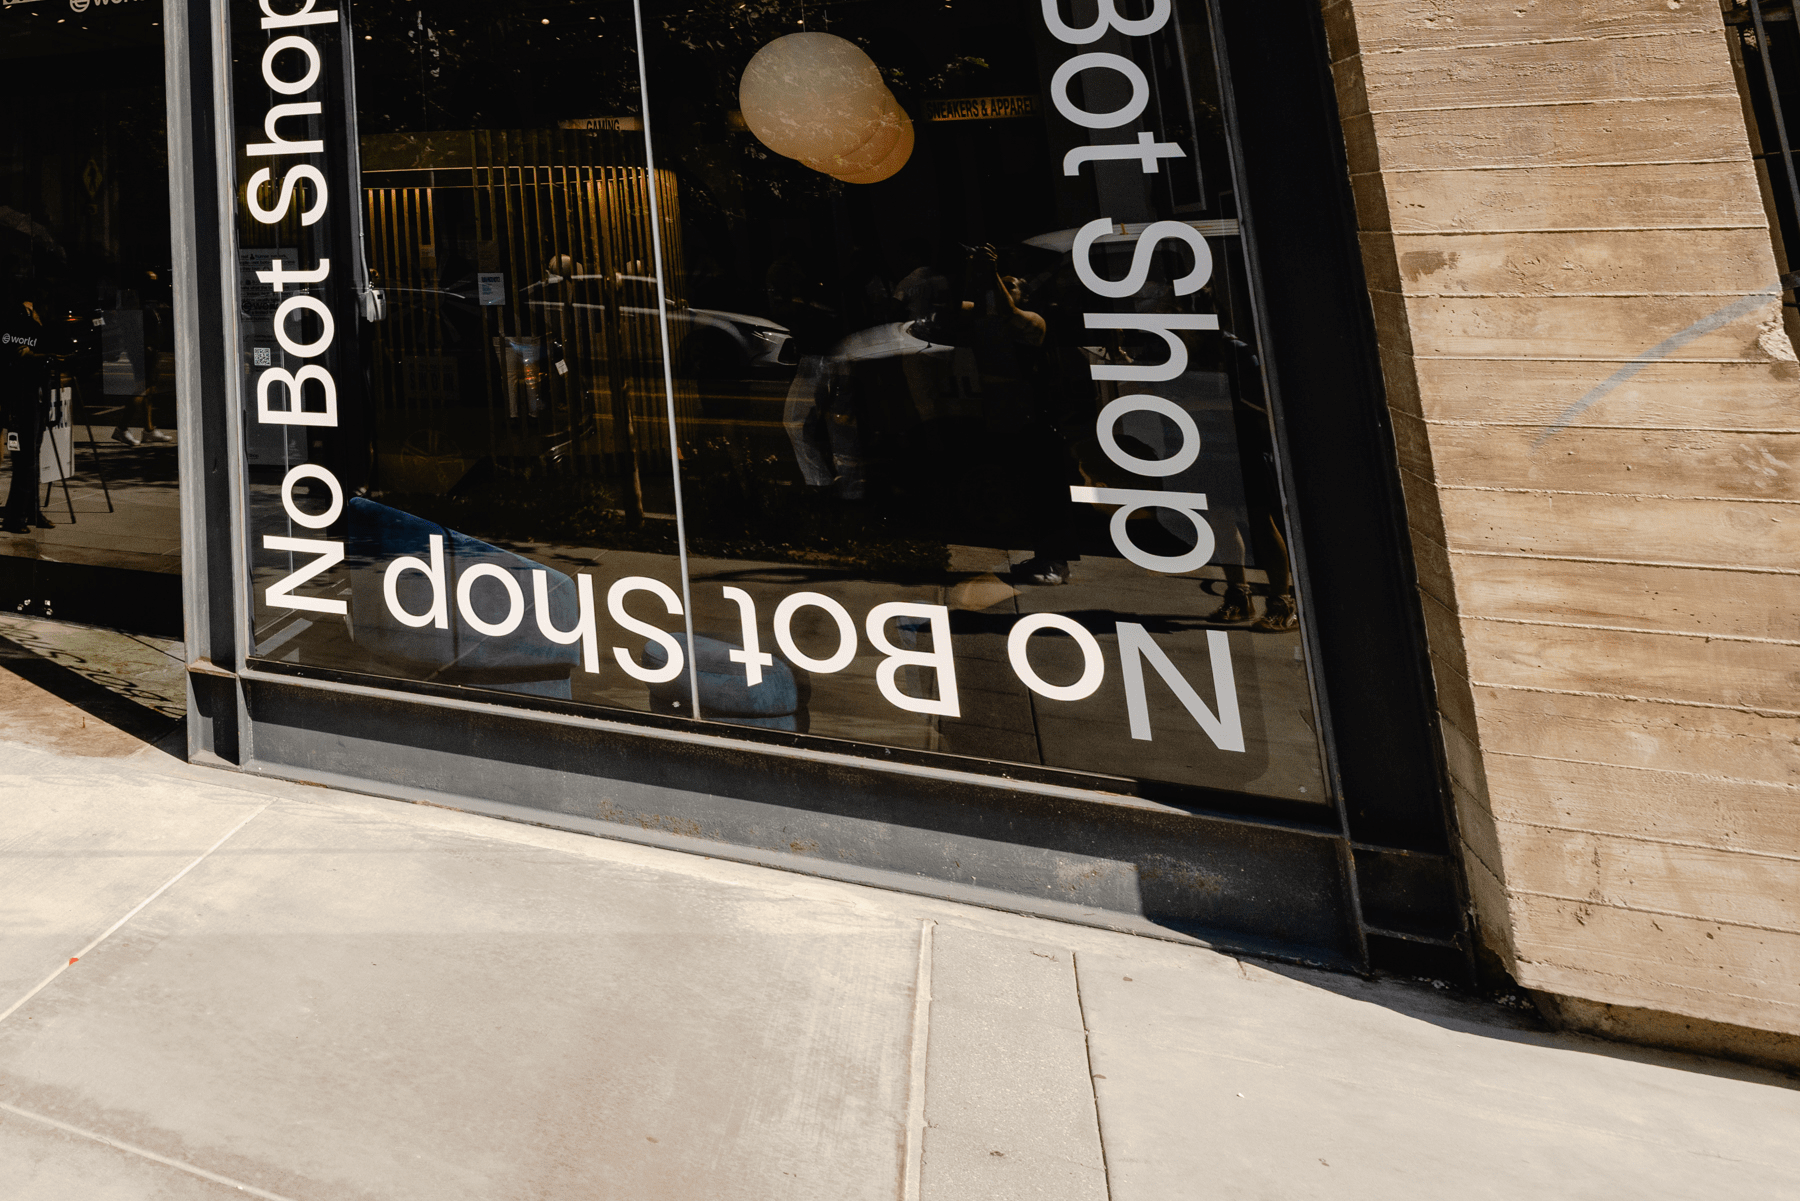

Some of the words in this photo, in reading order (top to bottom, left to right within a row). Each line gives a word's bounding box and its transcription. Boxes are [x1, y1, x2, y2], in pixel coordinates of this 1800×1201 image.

[926, 99, 979, 119] SNEAKERS
[981, 99, 988, 116] &
[991, 97, 1037, 116] APPAREL
[11, 334, 38, 347] world
[256, 257, 339, 428] Bot
[1069, 216, 1220, 574] Shop
[262, 463, 349, 615] No
[382, 534, 685, 683] Shop
[722, 585, 961, 718] Bot
[1007, 612, 1246, 754] No
